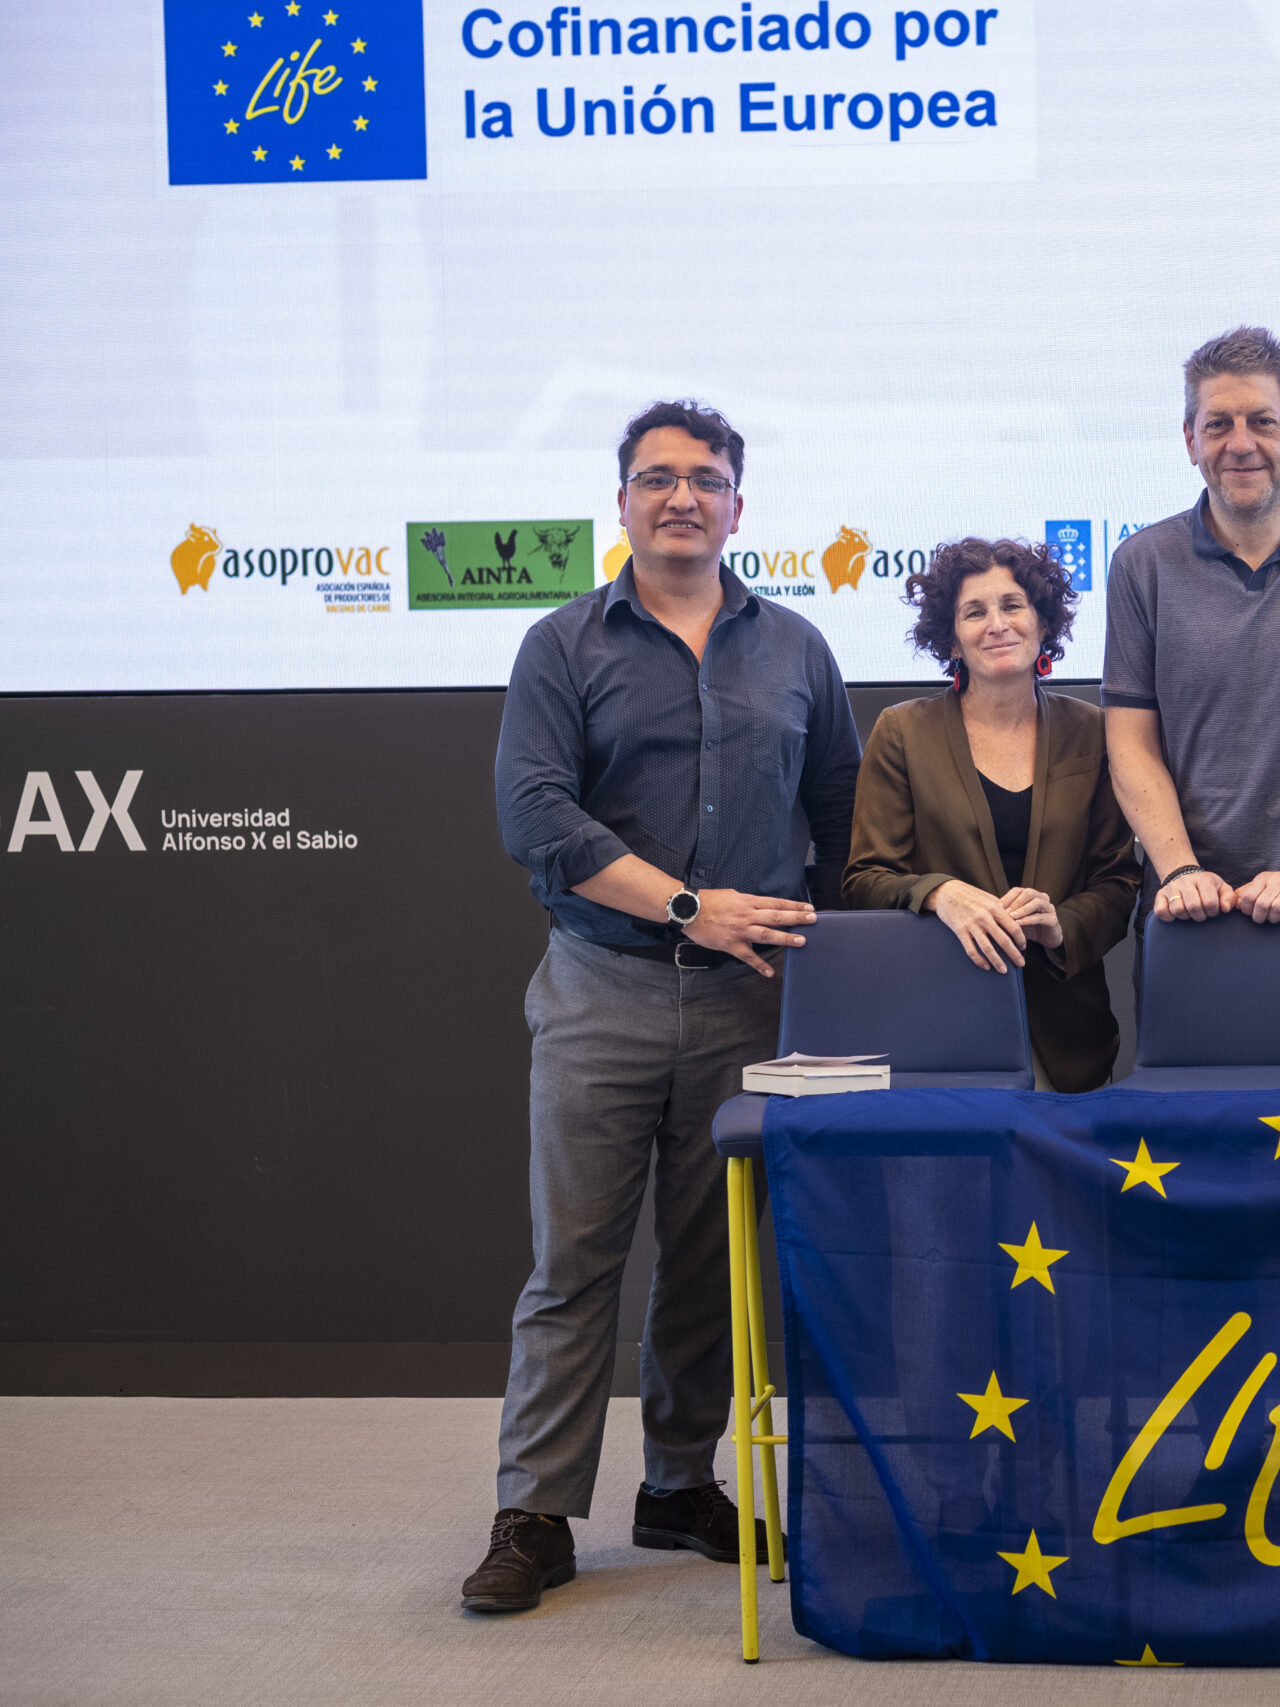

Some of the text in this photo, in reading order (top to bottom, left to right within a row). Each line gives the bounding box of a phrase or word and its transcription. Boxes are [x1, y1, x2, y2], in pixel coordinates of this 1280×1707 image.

[462, 0, 999, 61] Cofinanciado por
[245, 38, 344, 125] Life
[464, 82, 998, 142] la Unión Europea
[223, 547, 390, 586] asoprovac
[461, 567, 533, 585] AINTA
[720, 551, 815, 579] rovac
[784, 586, 791, 596] Y
[792, 584, 815, 596] LEÓN
[7, 770, 147, 853] AX
[161, 808, 290, 828] Universidad
[162, 830, 358, 851] Alfonso X el Sabio
